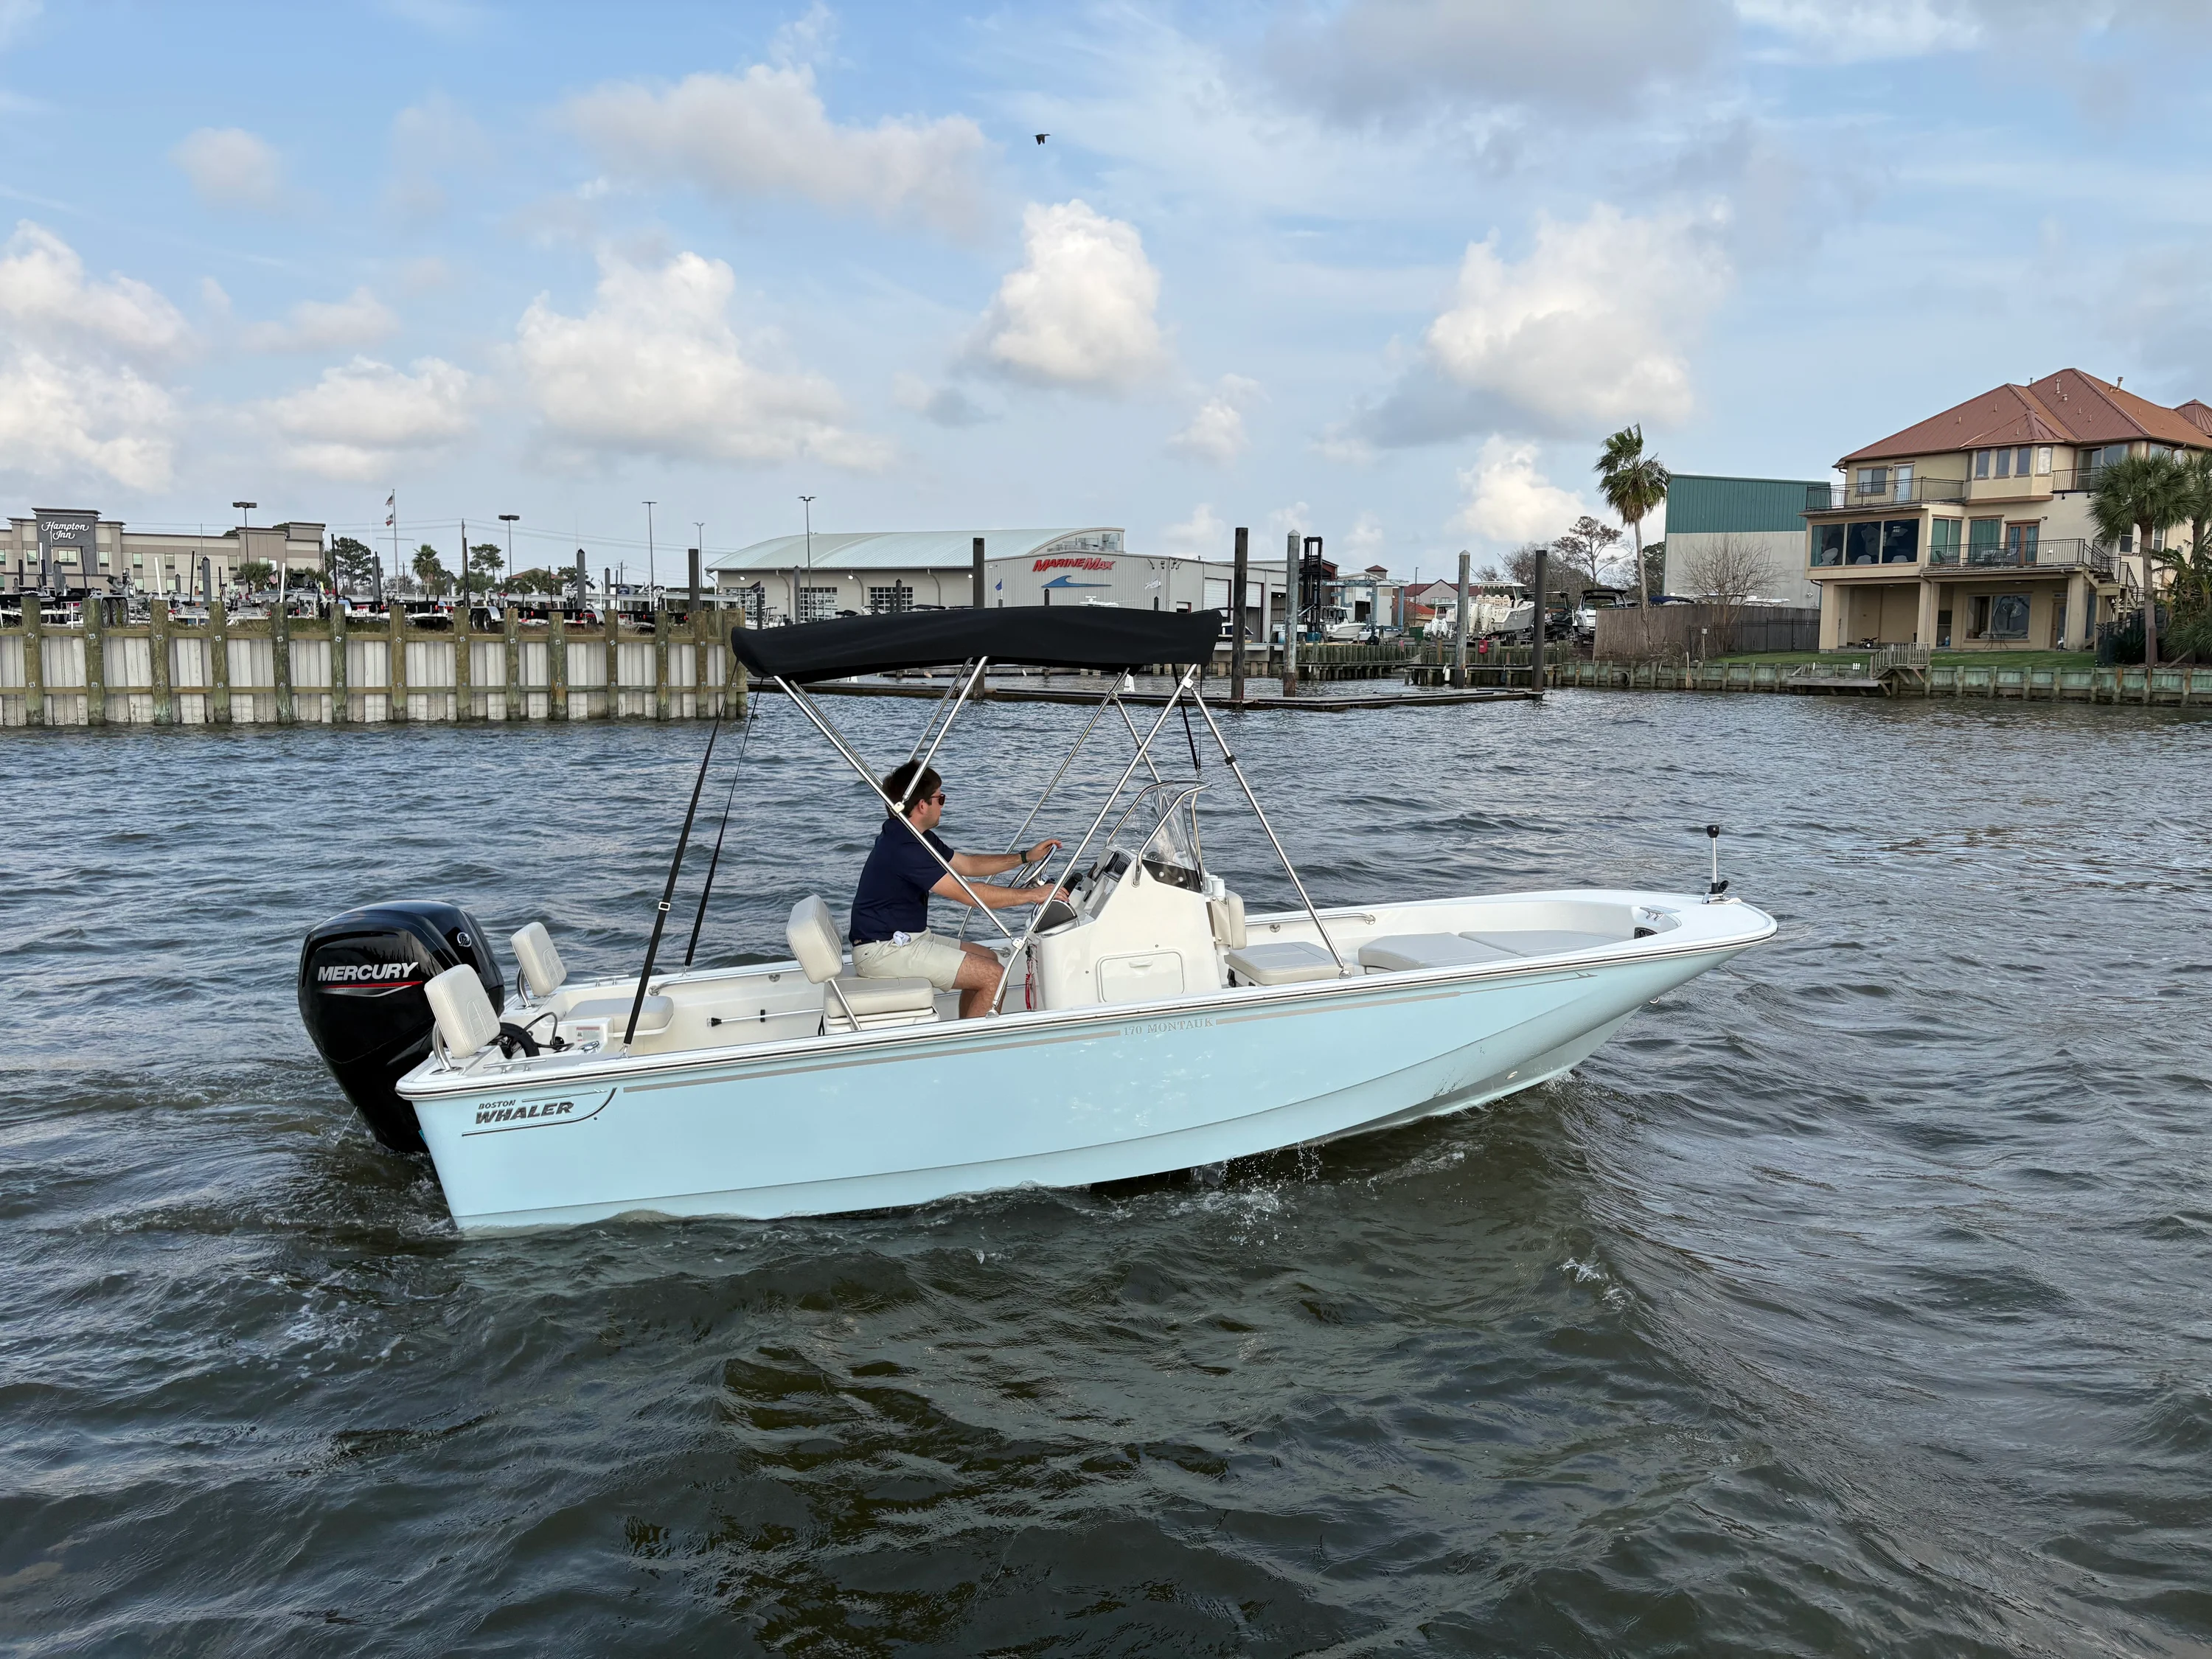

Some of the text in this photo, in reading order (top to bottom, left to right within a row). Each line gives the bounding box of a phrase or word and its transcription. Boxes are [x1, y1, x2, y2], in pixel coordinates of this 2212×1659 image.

[41, 521, 89, 532] Hampton
[52, 531, 75, 540] Inn
[317, 961, 419, 981] MERCURY
[1124, 1018, 1214, 1036] 170 MONTAUK
[478, 1099, 516, 1110] BOSTON
[475, 1101, 574, 1124] WHALER
